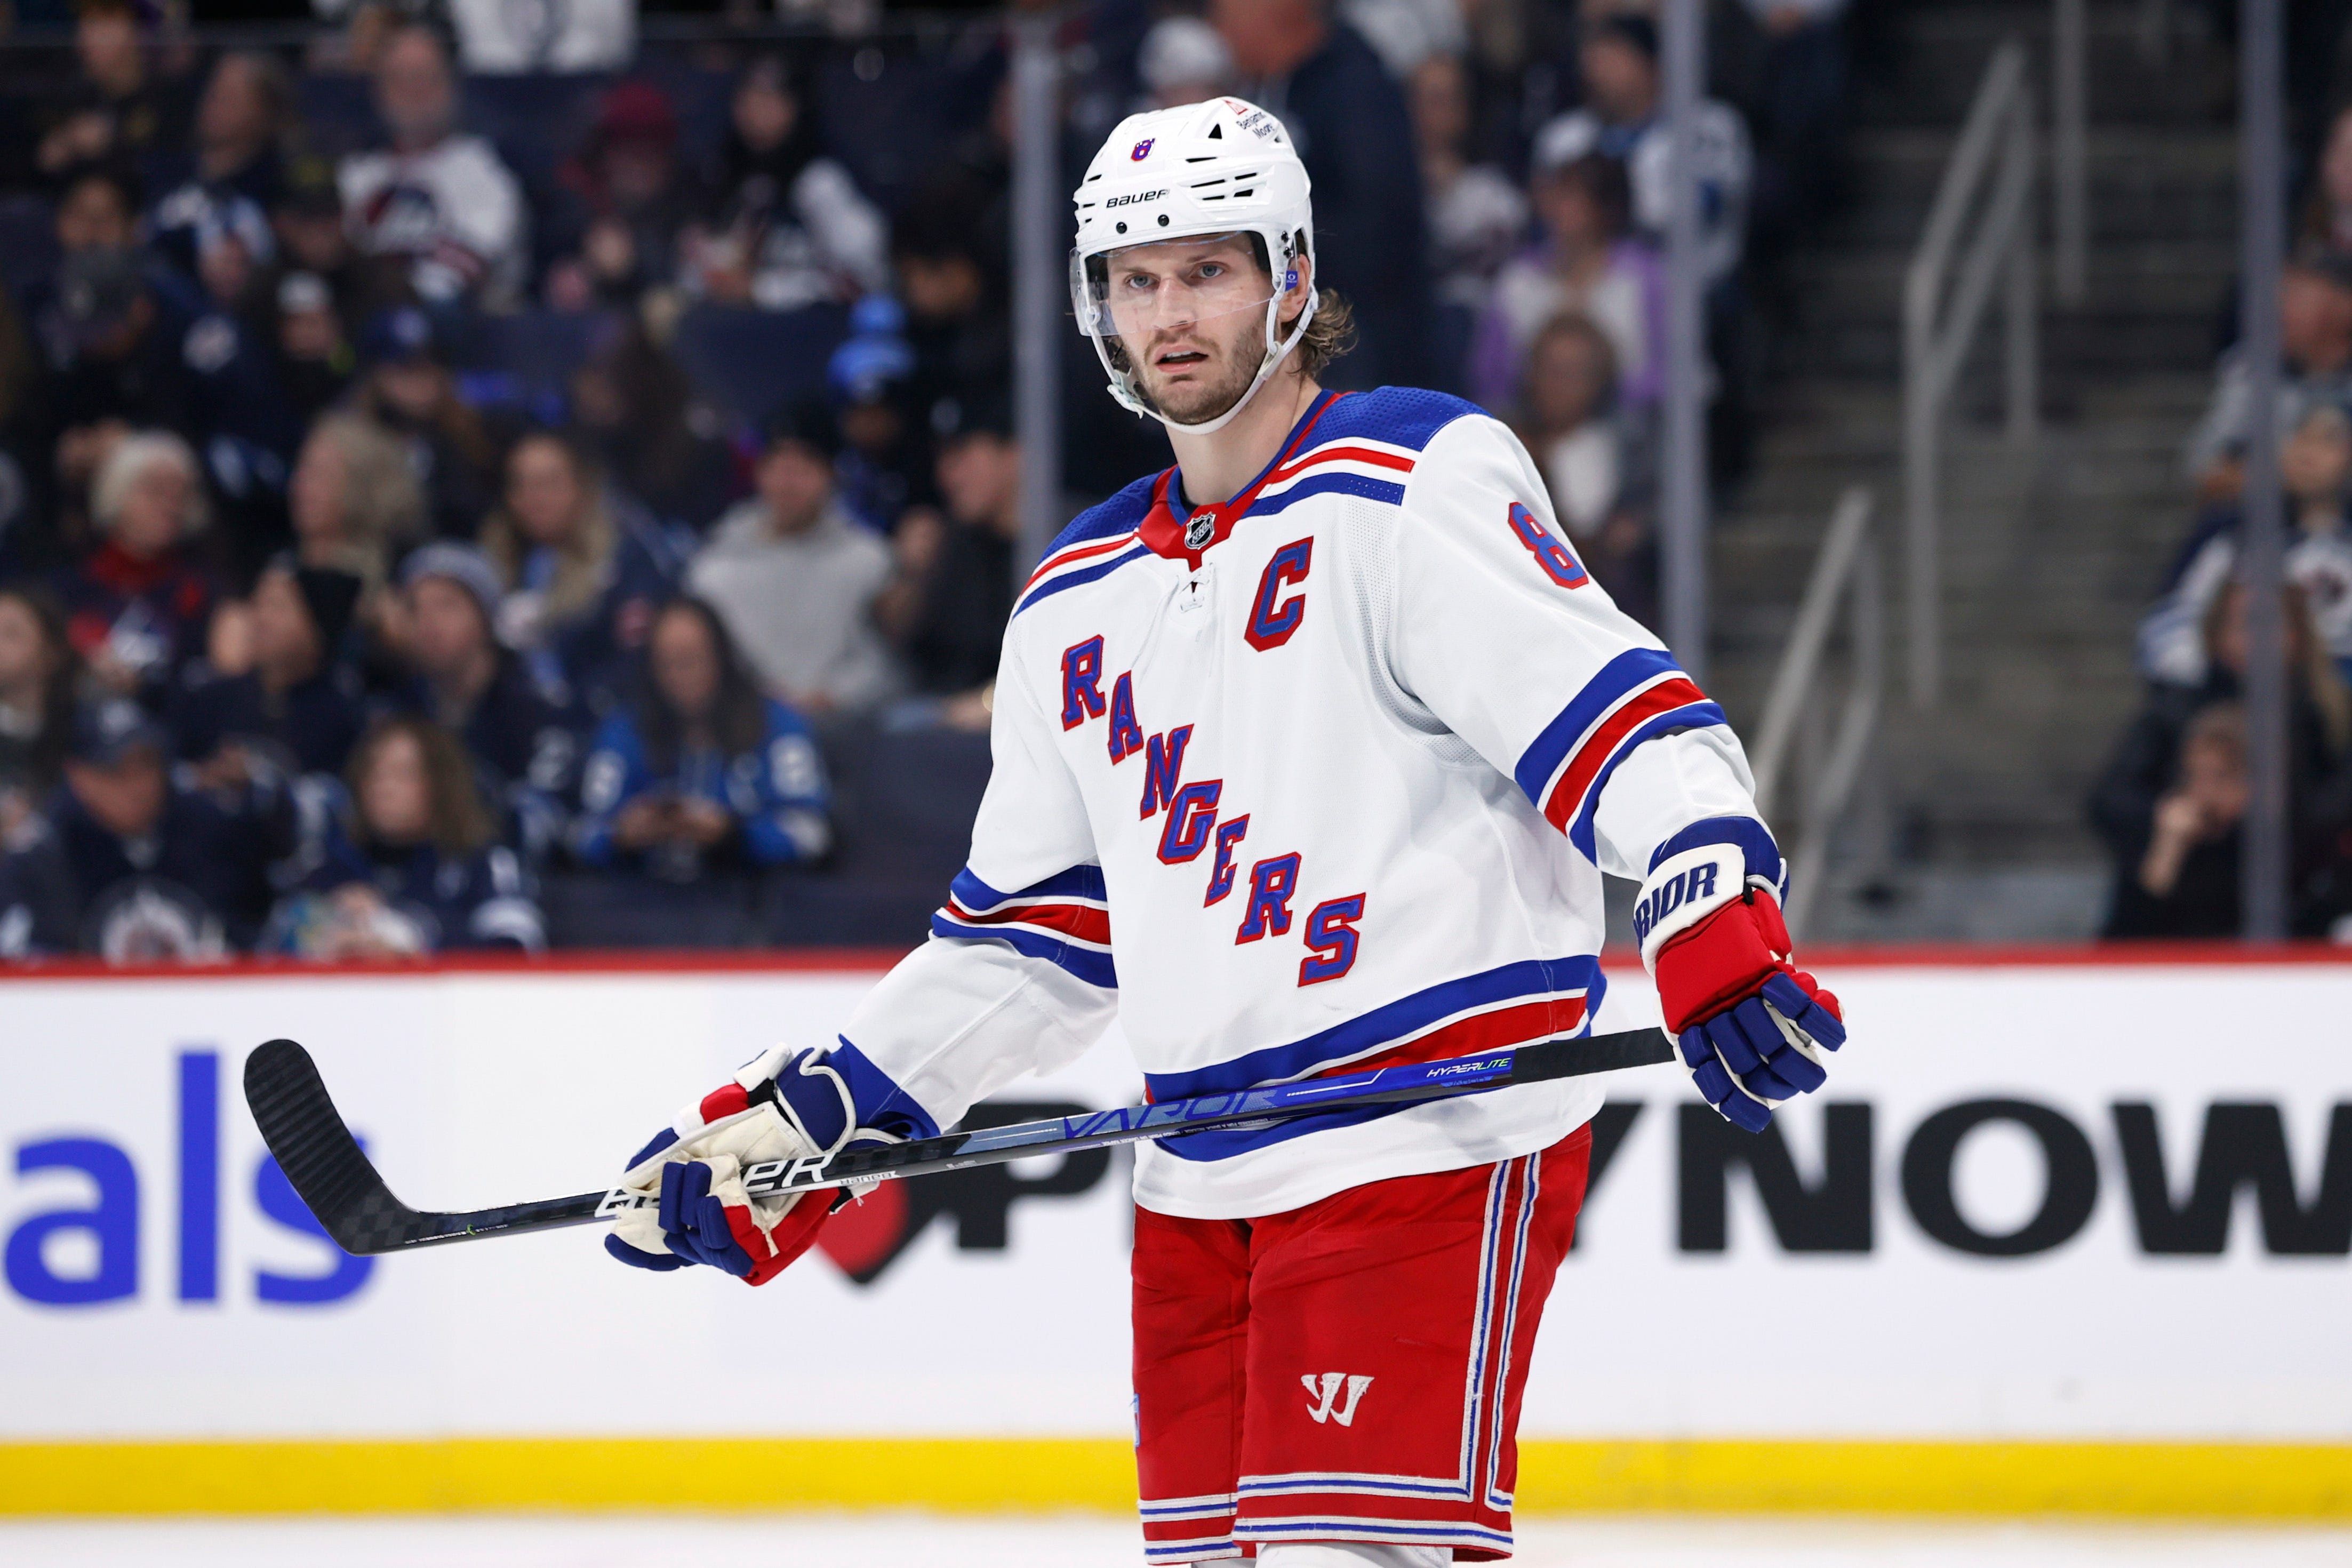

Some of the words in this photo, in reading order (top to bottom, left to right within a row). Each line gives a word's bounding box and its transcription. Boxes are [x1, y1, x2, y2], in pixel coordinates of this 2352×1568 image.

[1130, 138, 1155, 162] 8
[1508, 502, 1589, 590] 8
[1244, 535, 1314, 653] C
[1060, 634, 1366, 988] RANGERS
[1633, 861, 1719, 950] RIOR
[1426, 1058, 1511, 1078] HYPERLITE
